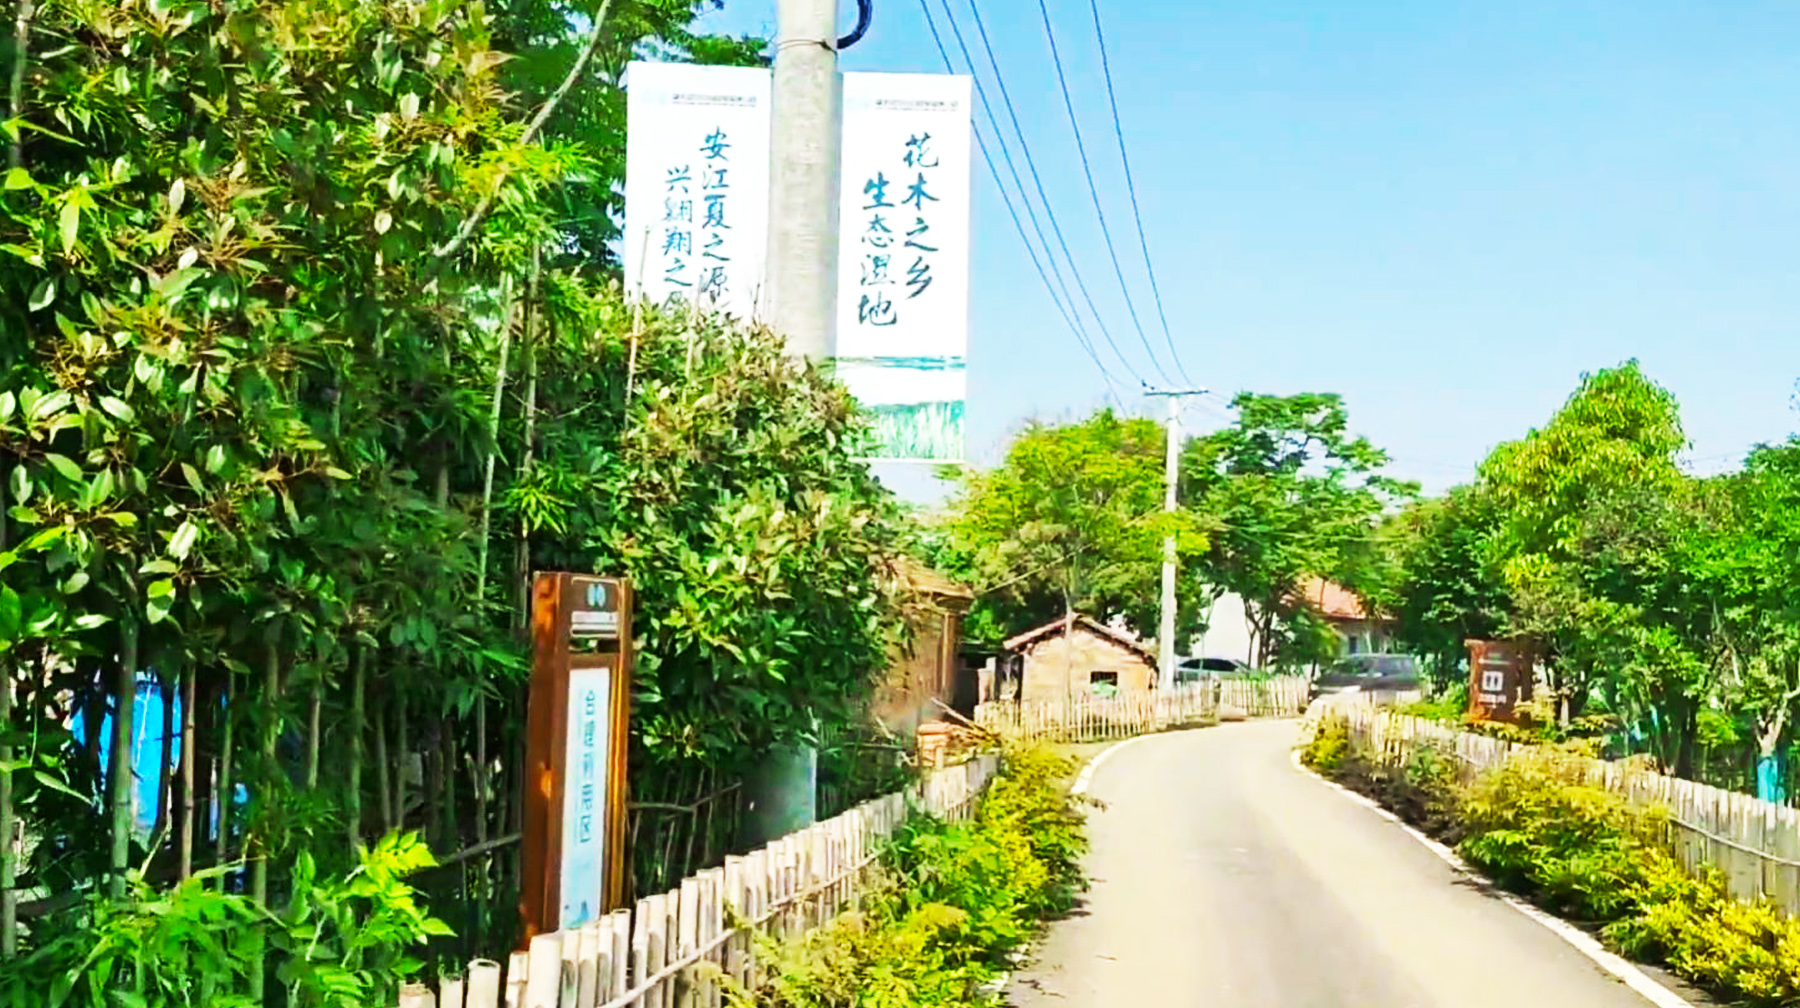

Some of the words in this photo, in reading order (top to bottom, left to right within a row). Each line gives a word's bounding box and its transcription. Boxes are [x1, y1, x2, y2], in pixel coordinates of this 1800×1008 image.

[858, 171, 897, 325] 生态湿地
[902, 132, 939, 299] 花木之乡
